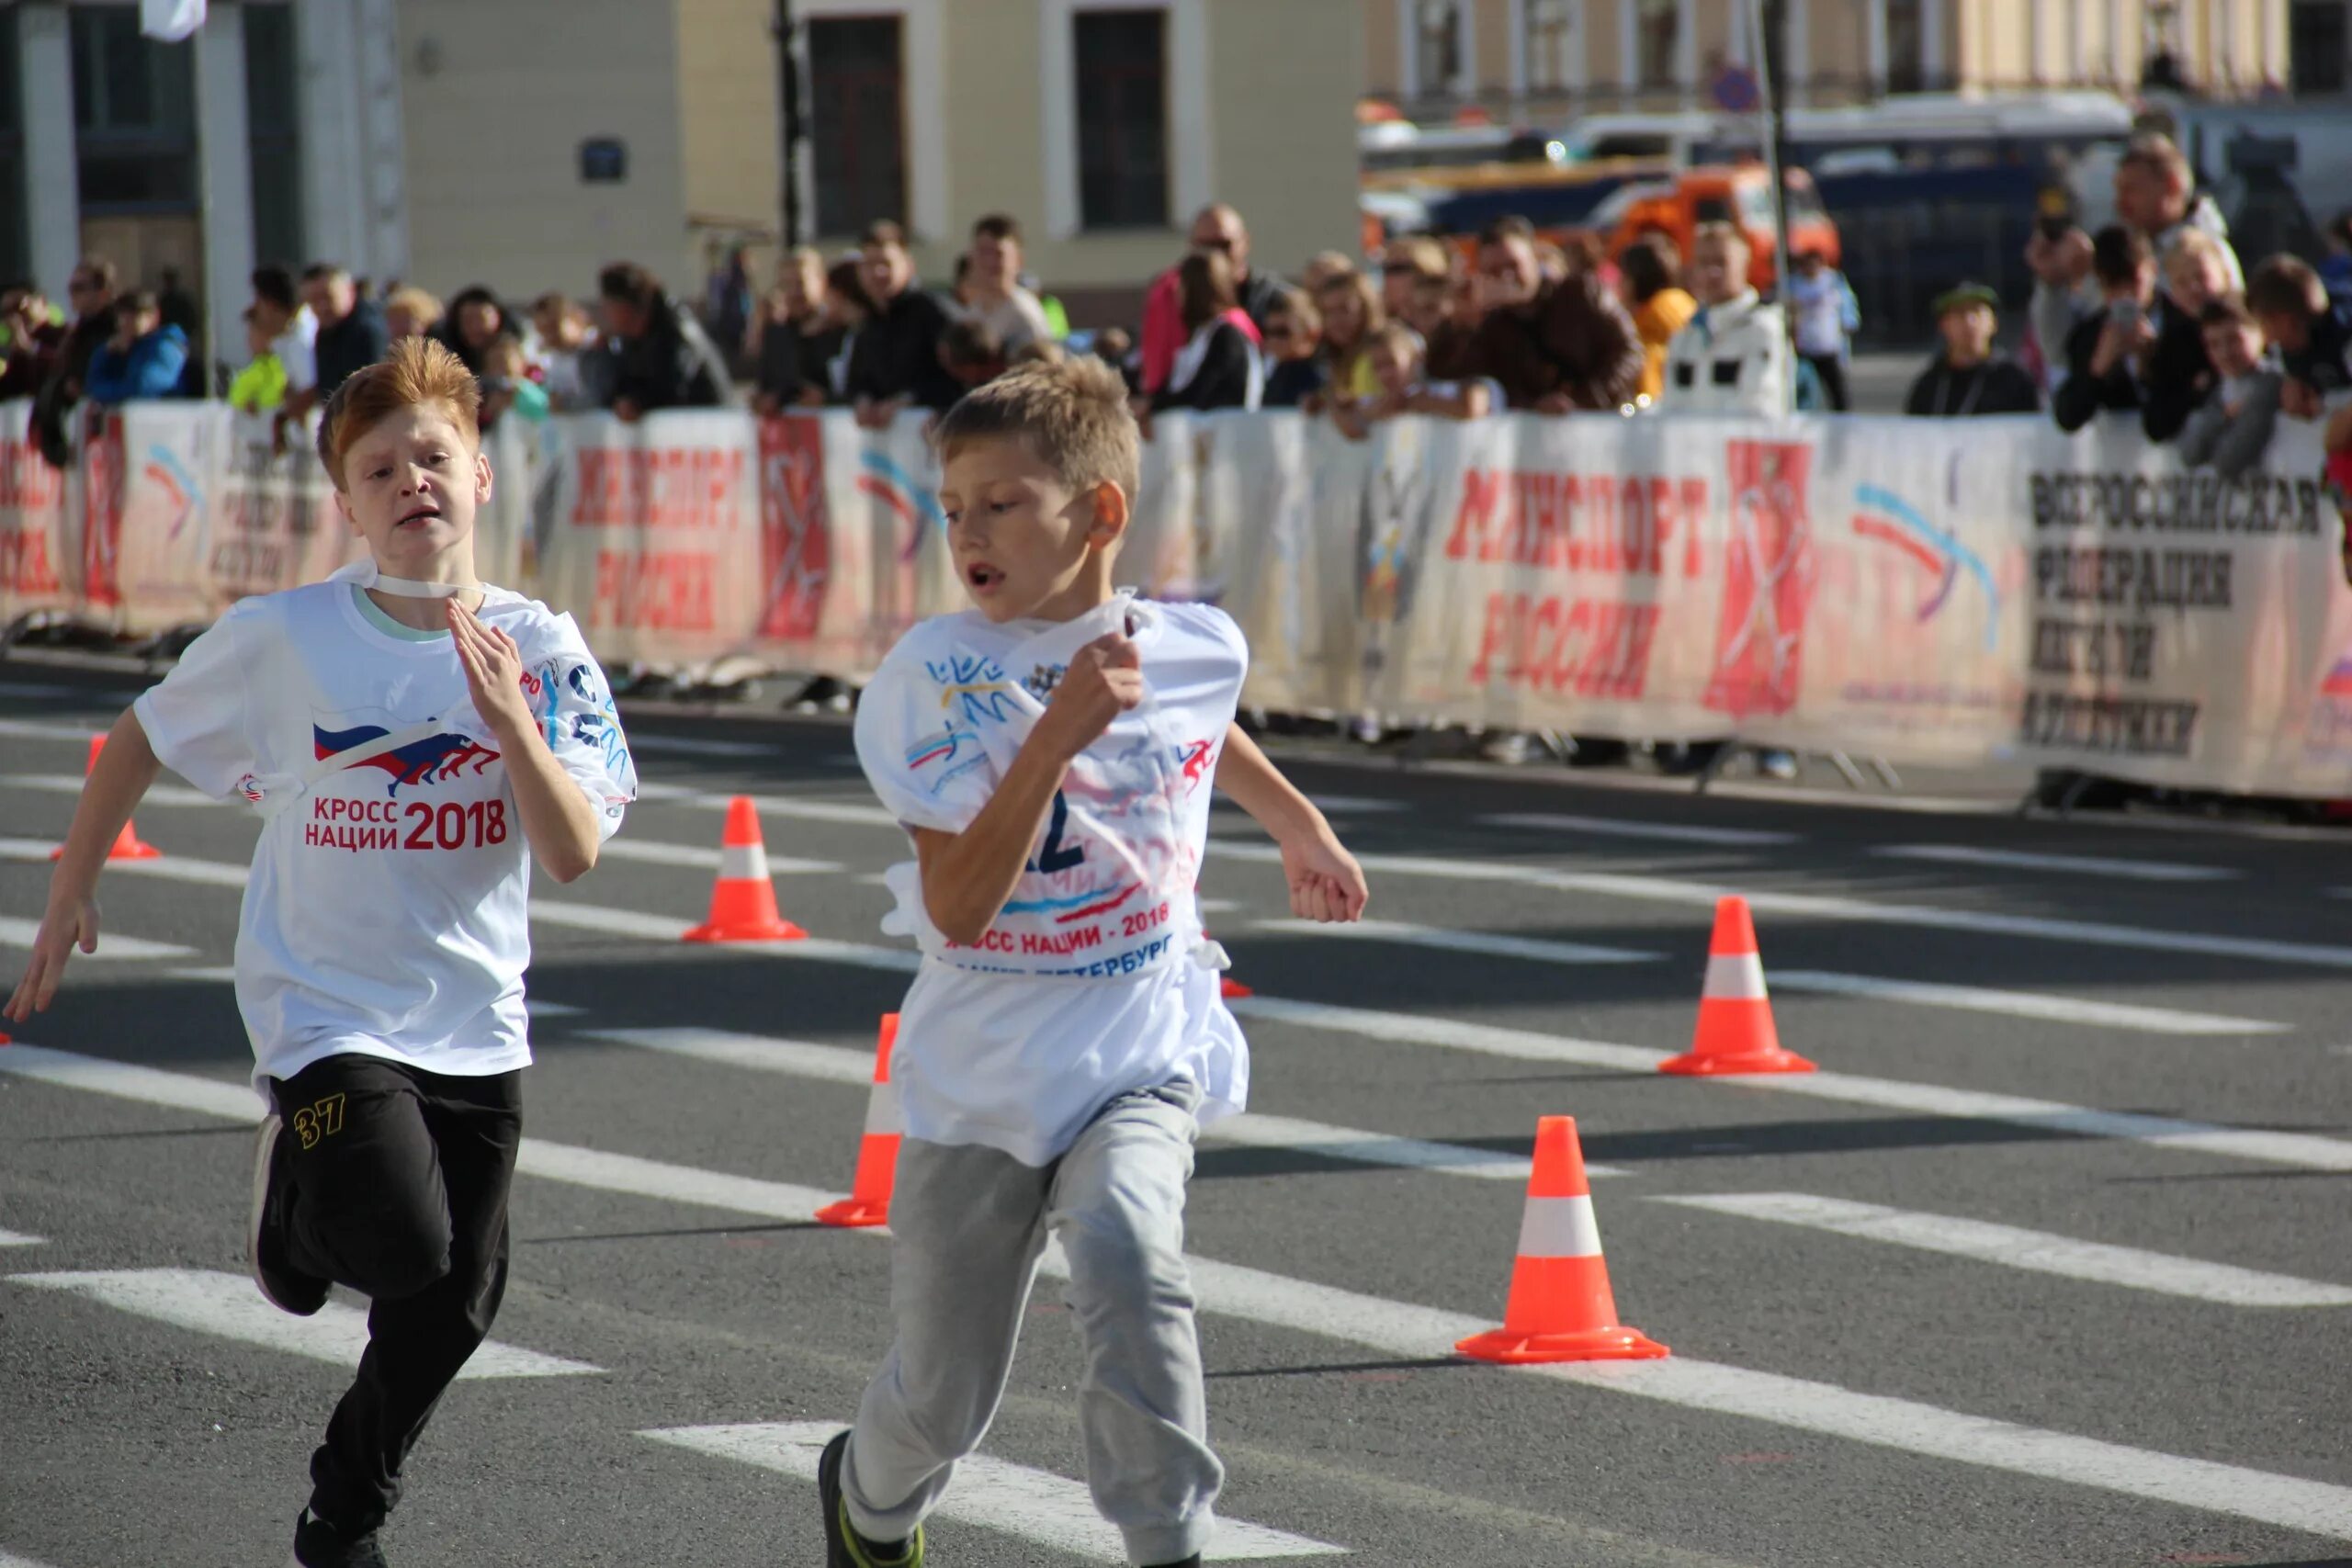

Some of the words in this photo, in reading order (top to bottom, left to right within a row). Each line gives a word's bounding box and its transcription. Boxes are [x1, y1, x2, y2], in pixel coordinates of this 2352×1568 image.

[314, 796, 398, 823] КРОСС
[403, 798, 506, 851] 2018
[305, 823, 397, 852] НАЦИИ
[1021, 925, 1102, 956] НАЦИИ
[1121, 901, 1170, 938] 2018
[294, 1092, 345, 1149] 37
